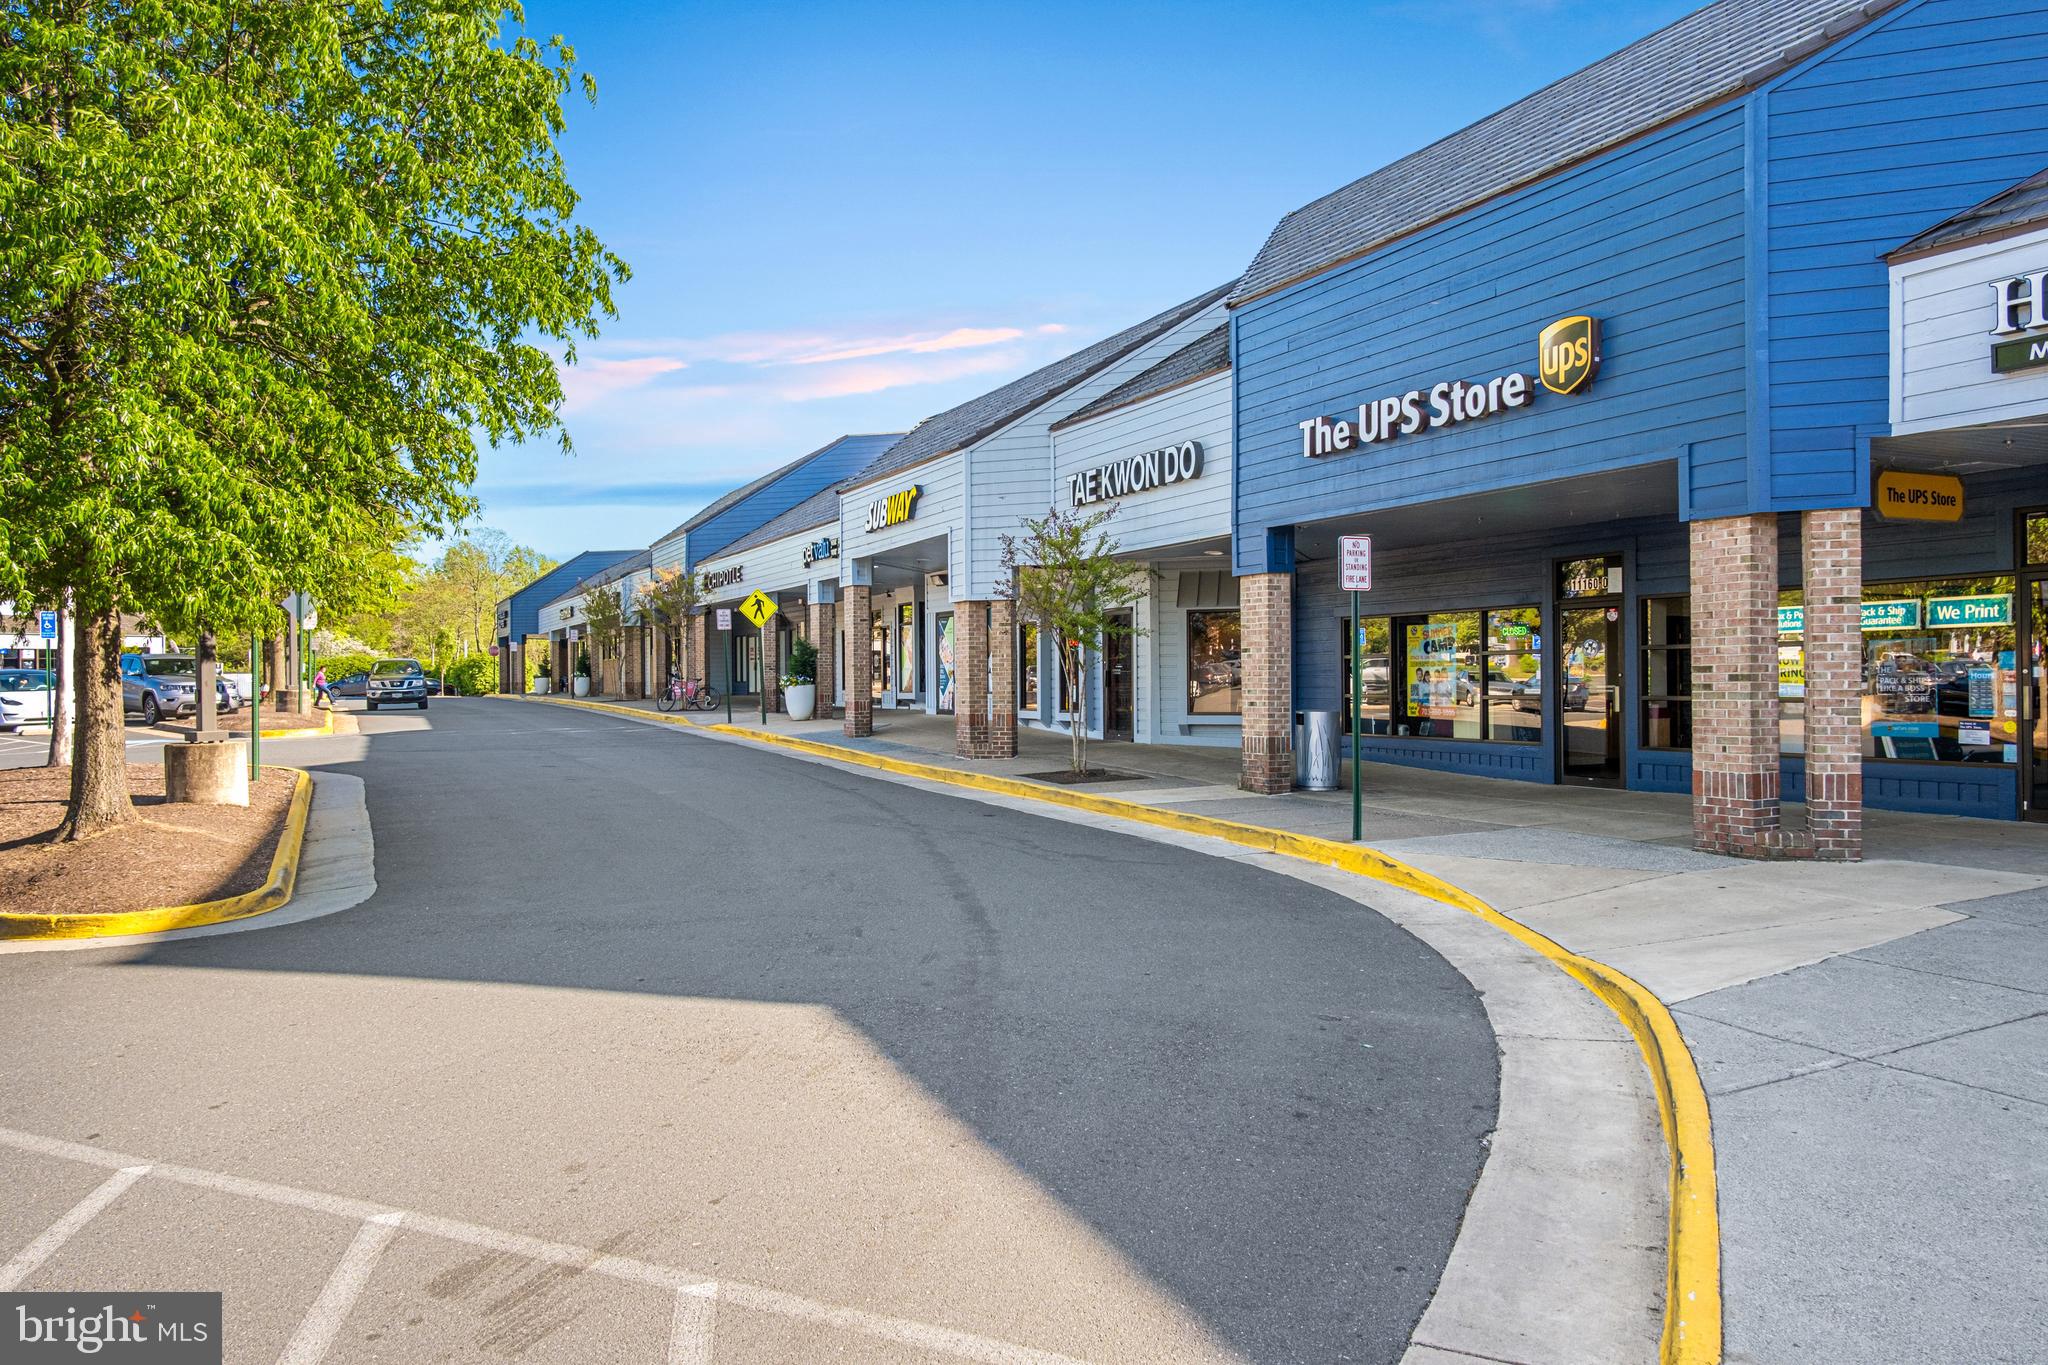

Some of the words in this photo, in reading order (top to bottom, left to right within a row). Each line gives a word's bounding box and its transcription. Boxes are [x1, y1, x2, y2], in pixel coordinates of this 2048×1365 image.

[1543, 336, 1588, 383] ups
[1299, 416, 1350, 458] The
[1358, 391, 1421, 443] UPS
[1429, 373, 1526, 427] Store
[1066, 469, 1097, 506] TAE
[1101, 450, 1159, 499] KWON
[1164, 440, 1196, 483] DO
[1887, 487, 1906, 503] The
[1908, 488, 1929, 505] UPS
[1931, 490, 1956, 507] Store
[864, 485, 917, 531] SUBWAY
[1352, 541, 1360, 549] NO
[1345, 563, 1368, 571] STANDING
[707, 566, 741, 589] CHIPOTLE
[1345, 575, 1355, 583] FIRE
[1356, 575, 1367, 583] LANE
[1861, 607, 1876, 617] ack
[1887, 605, 1906, 619] Ship
[1936, 606, 1960, 620] We
[1965, 604, 2000, 619] Print
[1502, 626, 1527, 636] CLOSED
[1880, 677, 1899, 685] PACK
[1905, 695, 1931, 703] STORE
